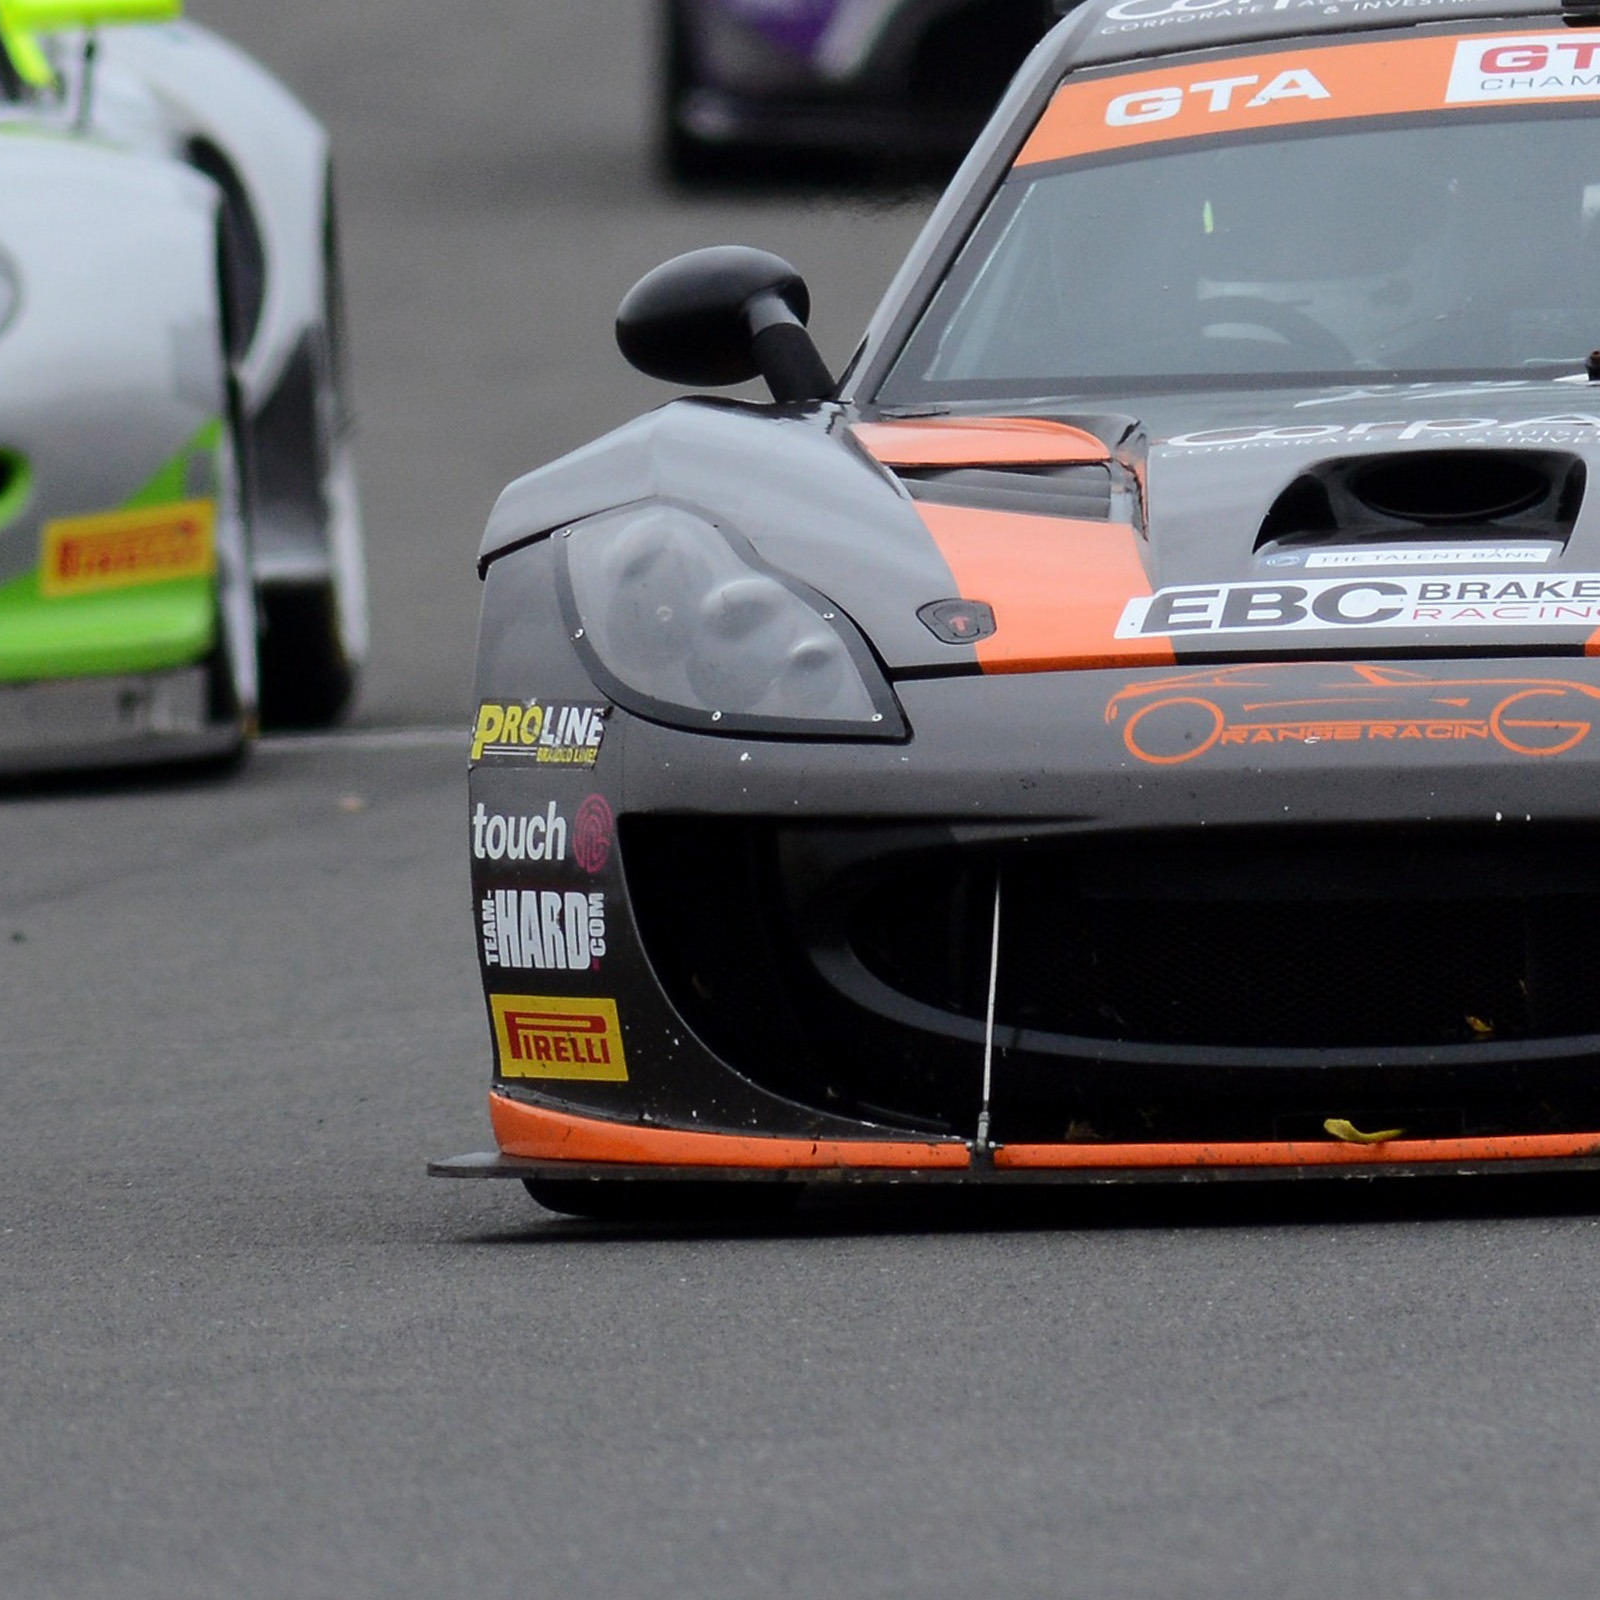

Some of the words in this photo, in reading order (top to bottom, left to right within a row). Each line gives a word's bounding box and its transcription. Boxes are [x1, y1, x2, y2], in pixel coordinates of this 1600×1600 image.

[1101, 4, 1267, 35] CORPORATE
[1322, 3, 1340, 16] &
[1104, 67, 1330, 127] GTA
[1140, 580, 1408, 634] EBC
[473, 800, 567, 861] touch
[495, 889, 591, 971] HARD
[504, 1010, 611, 1065] PIRELLI
